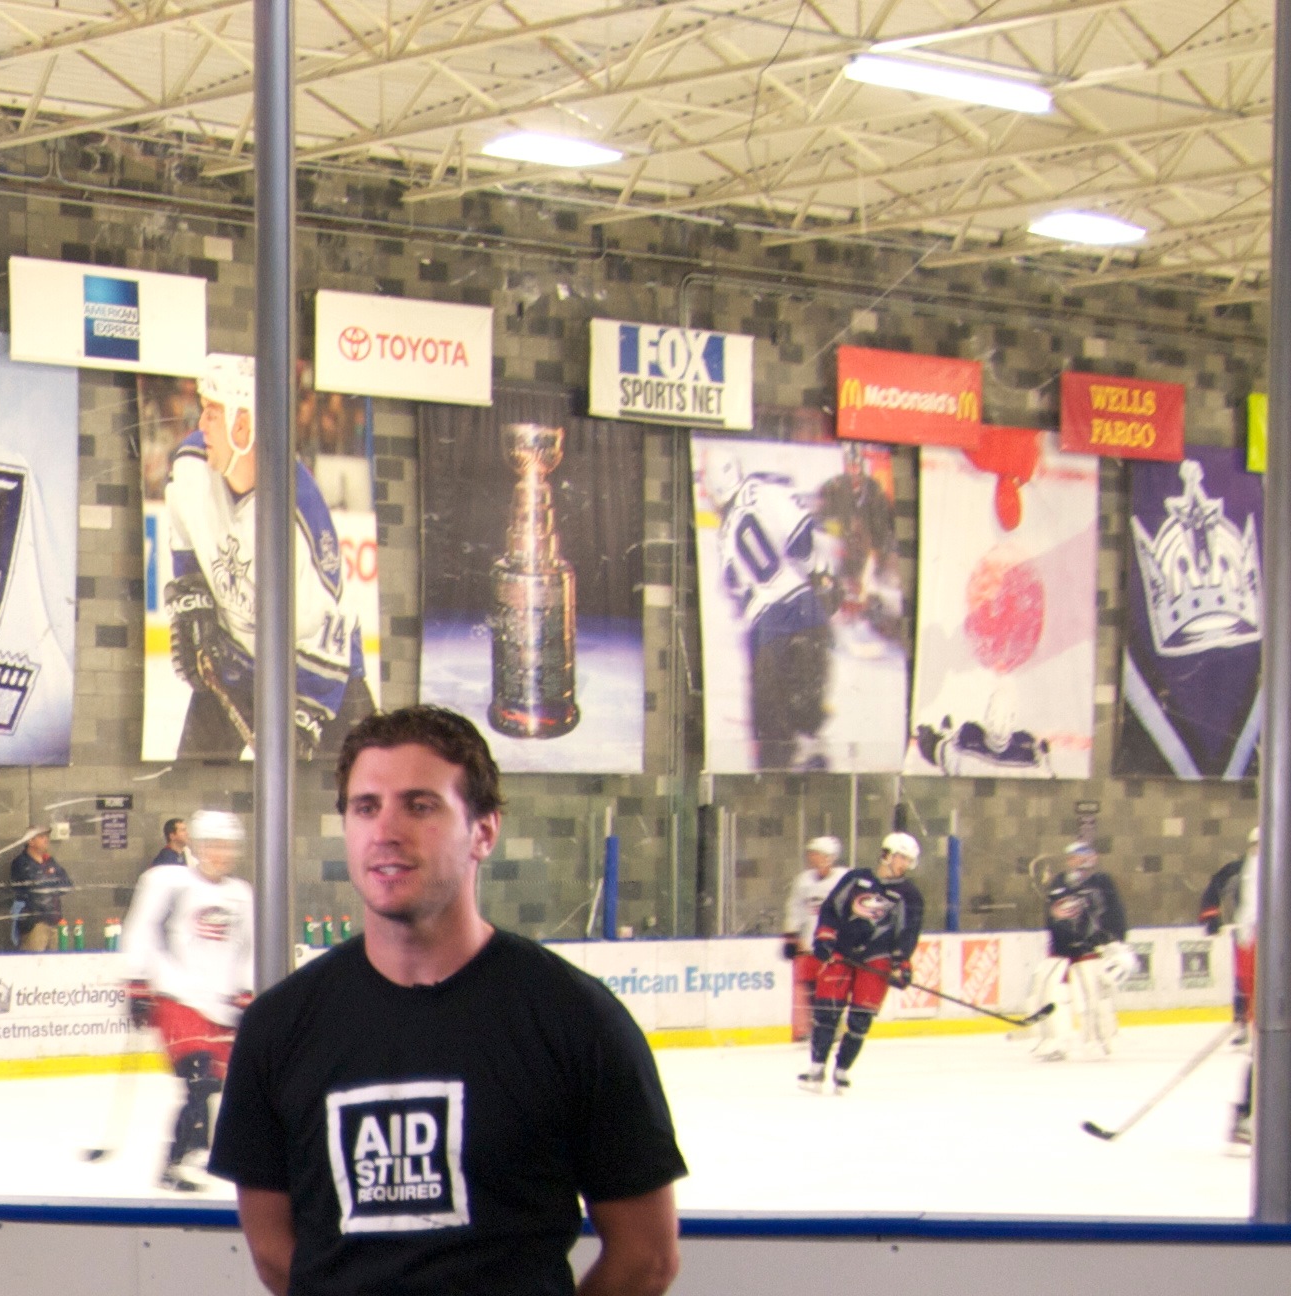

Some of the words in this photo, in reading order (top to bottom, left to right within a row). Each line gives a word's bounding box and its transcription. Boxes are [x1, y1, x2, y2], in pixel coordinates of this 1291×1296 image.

[376, 333, 469, 368] TOYOTA
[638, 325, 713, 382] FOX
[620, 377, 687, 412] SPORTS
[692, 384, 724, 415] NET
[863, 383, 958, 415] McDonald's
[1089, 384, 1156, 416] WELLS
[1089, 418, 1156, 448] FARGO
[16, 984, 126, 1008] ticketexchange
[600, 968, 679, 994] erican
[685, 965, 775, 998] Express
[354, 1112, 438, 1160] AID
[354, 1156, 441, 1187] STILL
[356, 1183, 442, 1204] REQUIRED
